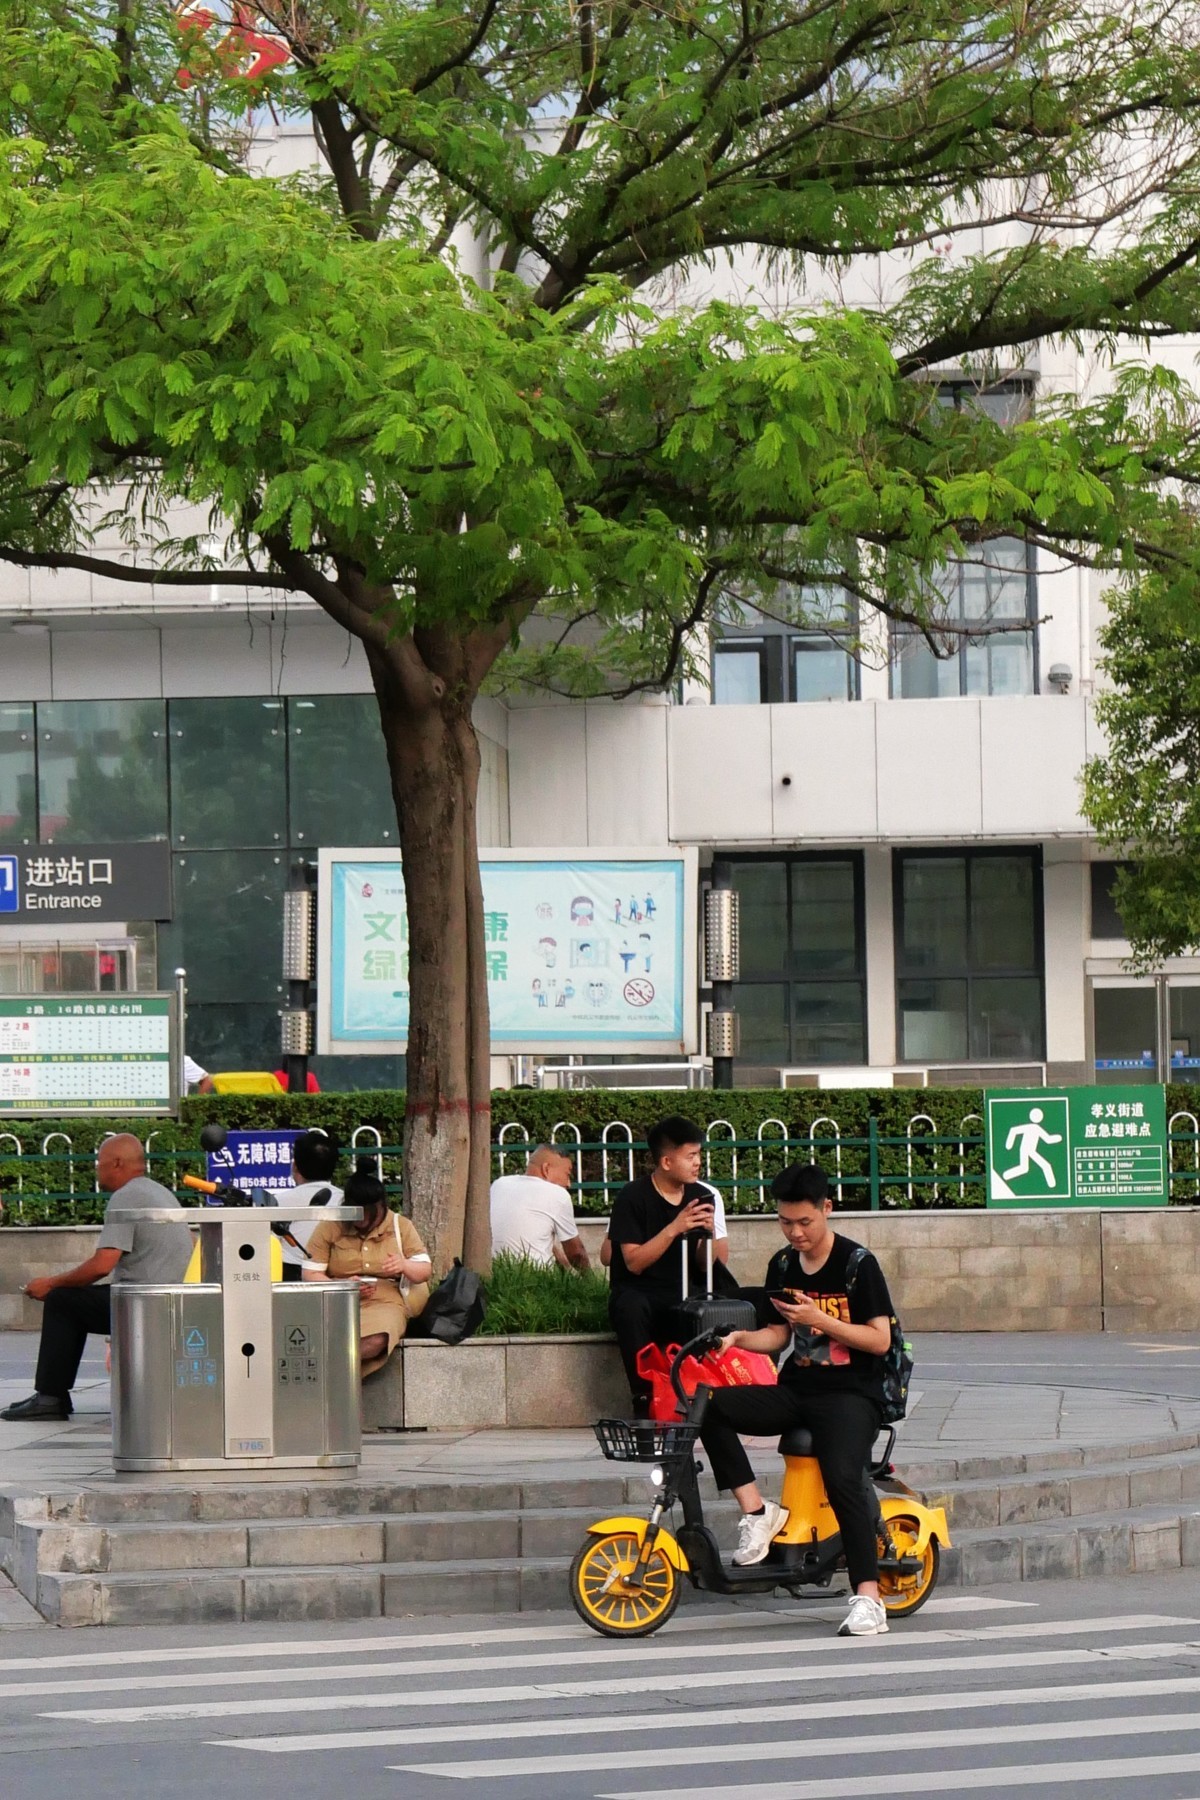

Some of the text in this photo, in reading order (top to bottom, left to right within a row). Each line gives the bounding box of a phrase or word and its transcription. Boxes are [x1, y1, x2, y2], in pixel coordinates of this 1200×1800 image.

[26, 856, 113, 887] 进站口
[25, 893, 102, 909] Entrance
[1091, 1103, 1144, 1118] 孝义街道
[1084, 1122, 1151, 1138] 应急避难点
[237, 1142, 295, 1165] 无障碍通
[233, 1272, 261, 1282] 灭烟处
[238, 1441, 264, 1451] 1765
